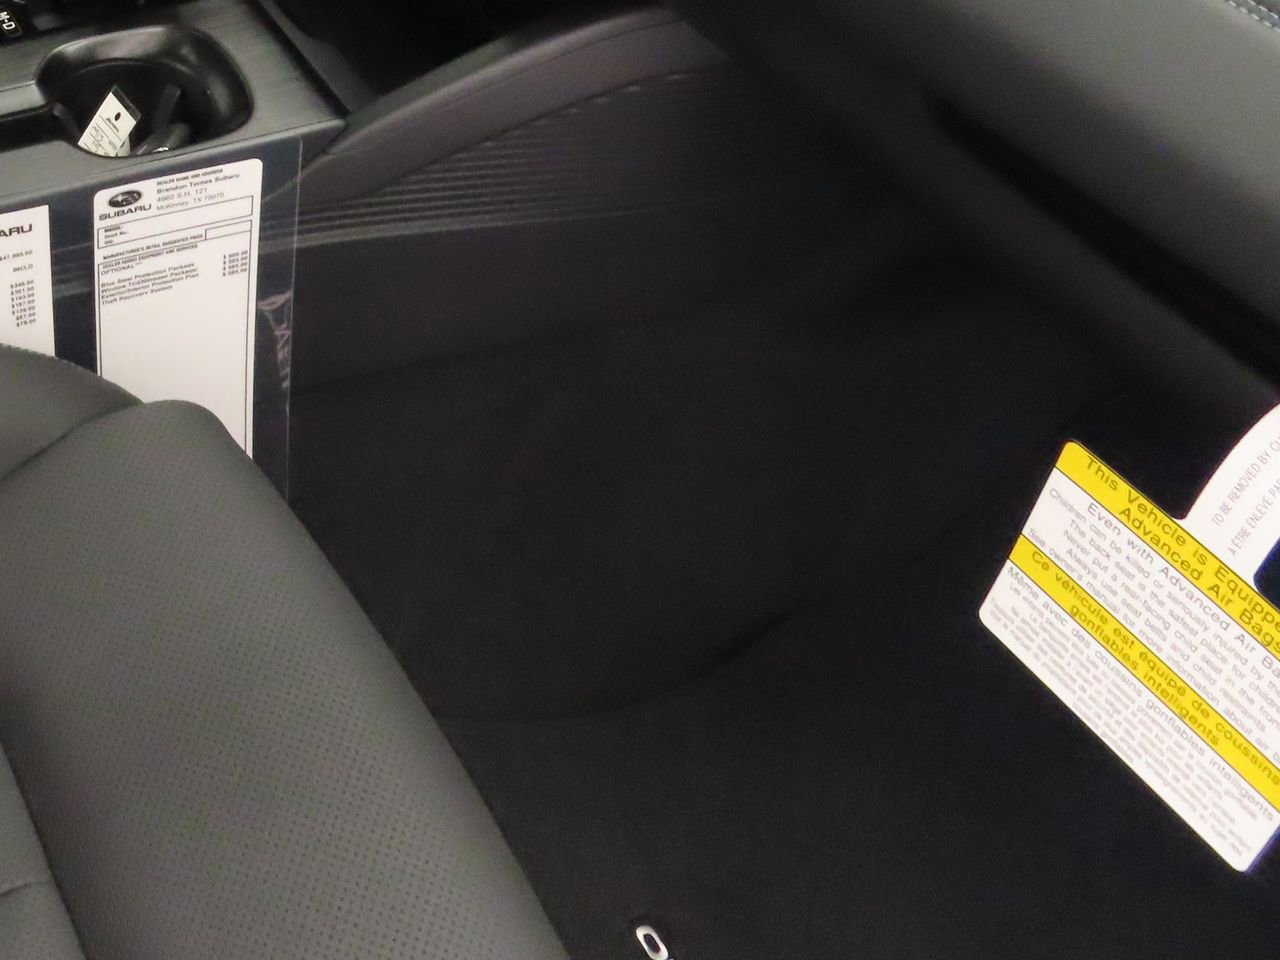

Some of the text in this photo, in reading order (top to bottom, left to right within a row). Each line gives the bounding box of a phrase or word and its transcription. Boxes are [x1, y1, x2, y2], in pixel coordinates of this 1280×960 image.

[98, 203, 151, 220] SUBARU
[1083, 455, 1121, 492] This
[1123, 488, 1188, 549] Vehicle
[1191, 546, 1209, 568] is
[1108, 538, 1123, 556] be
[1151, 577, 1164, 592] or
[1117, 502, 1204, 584] Advanced
[1205, 578, 1234, 610] Air
[1086, 501, 1123, 538] Even
[1125, 534, 1155, 566] with
[1157, 562, 1231, 633] Advanced
[1232, 628, 1257, 656] Air
[1029, 548, 1052, 574] Ce
[1111, 623, 1135, 651] est
[1189, 694, 1212, 722] de
[1215, 721, 1280, 786] coussins
